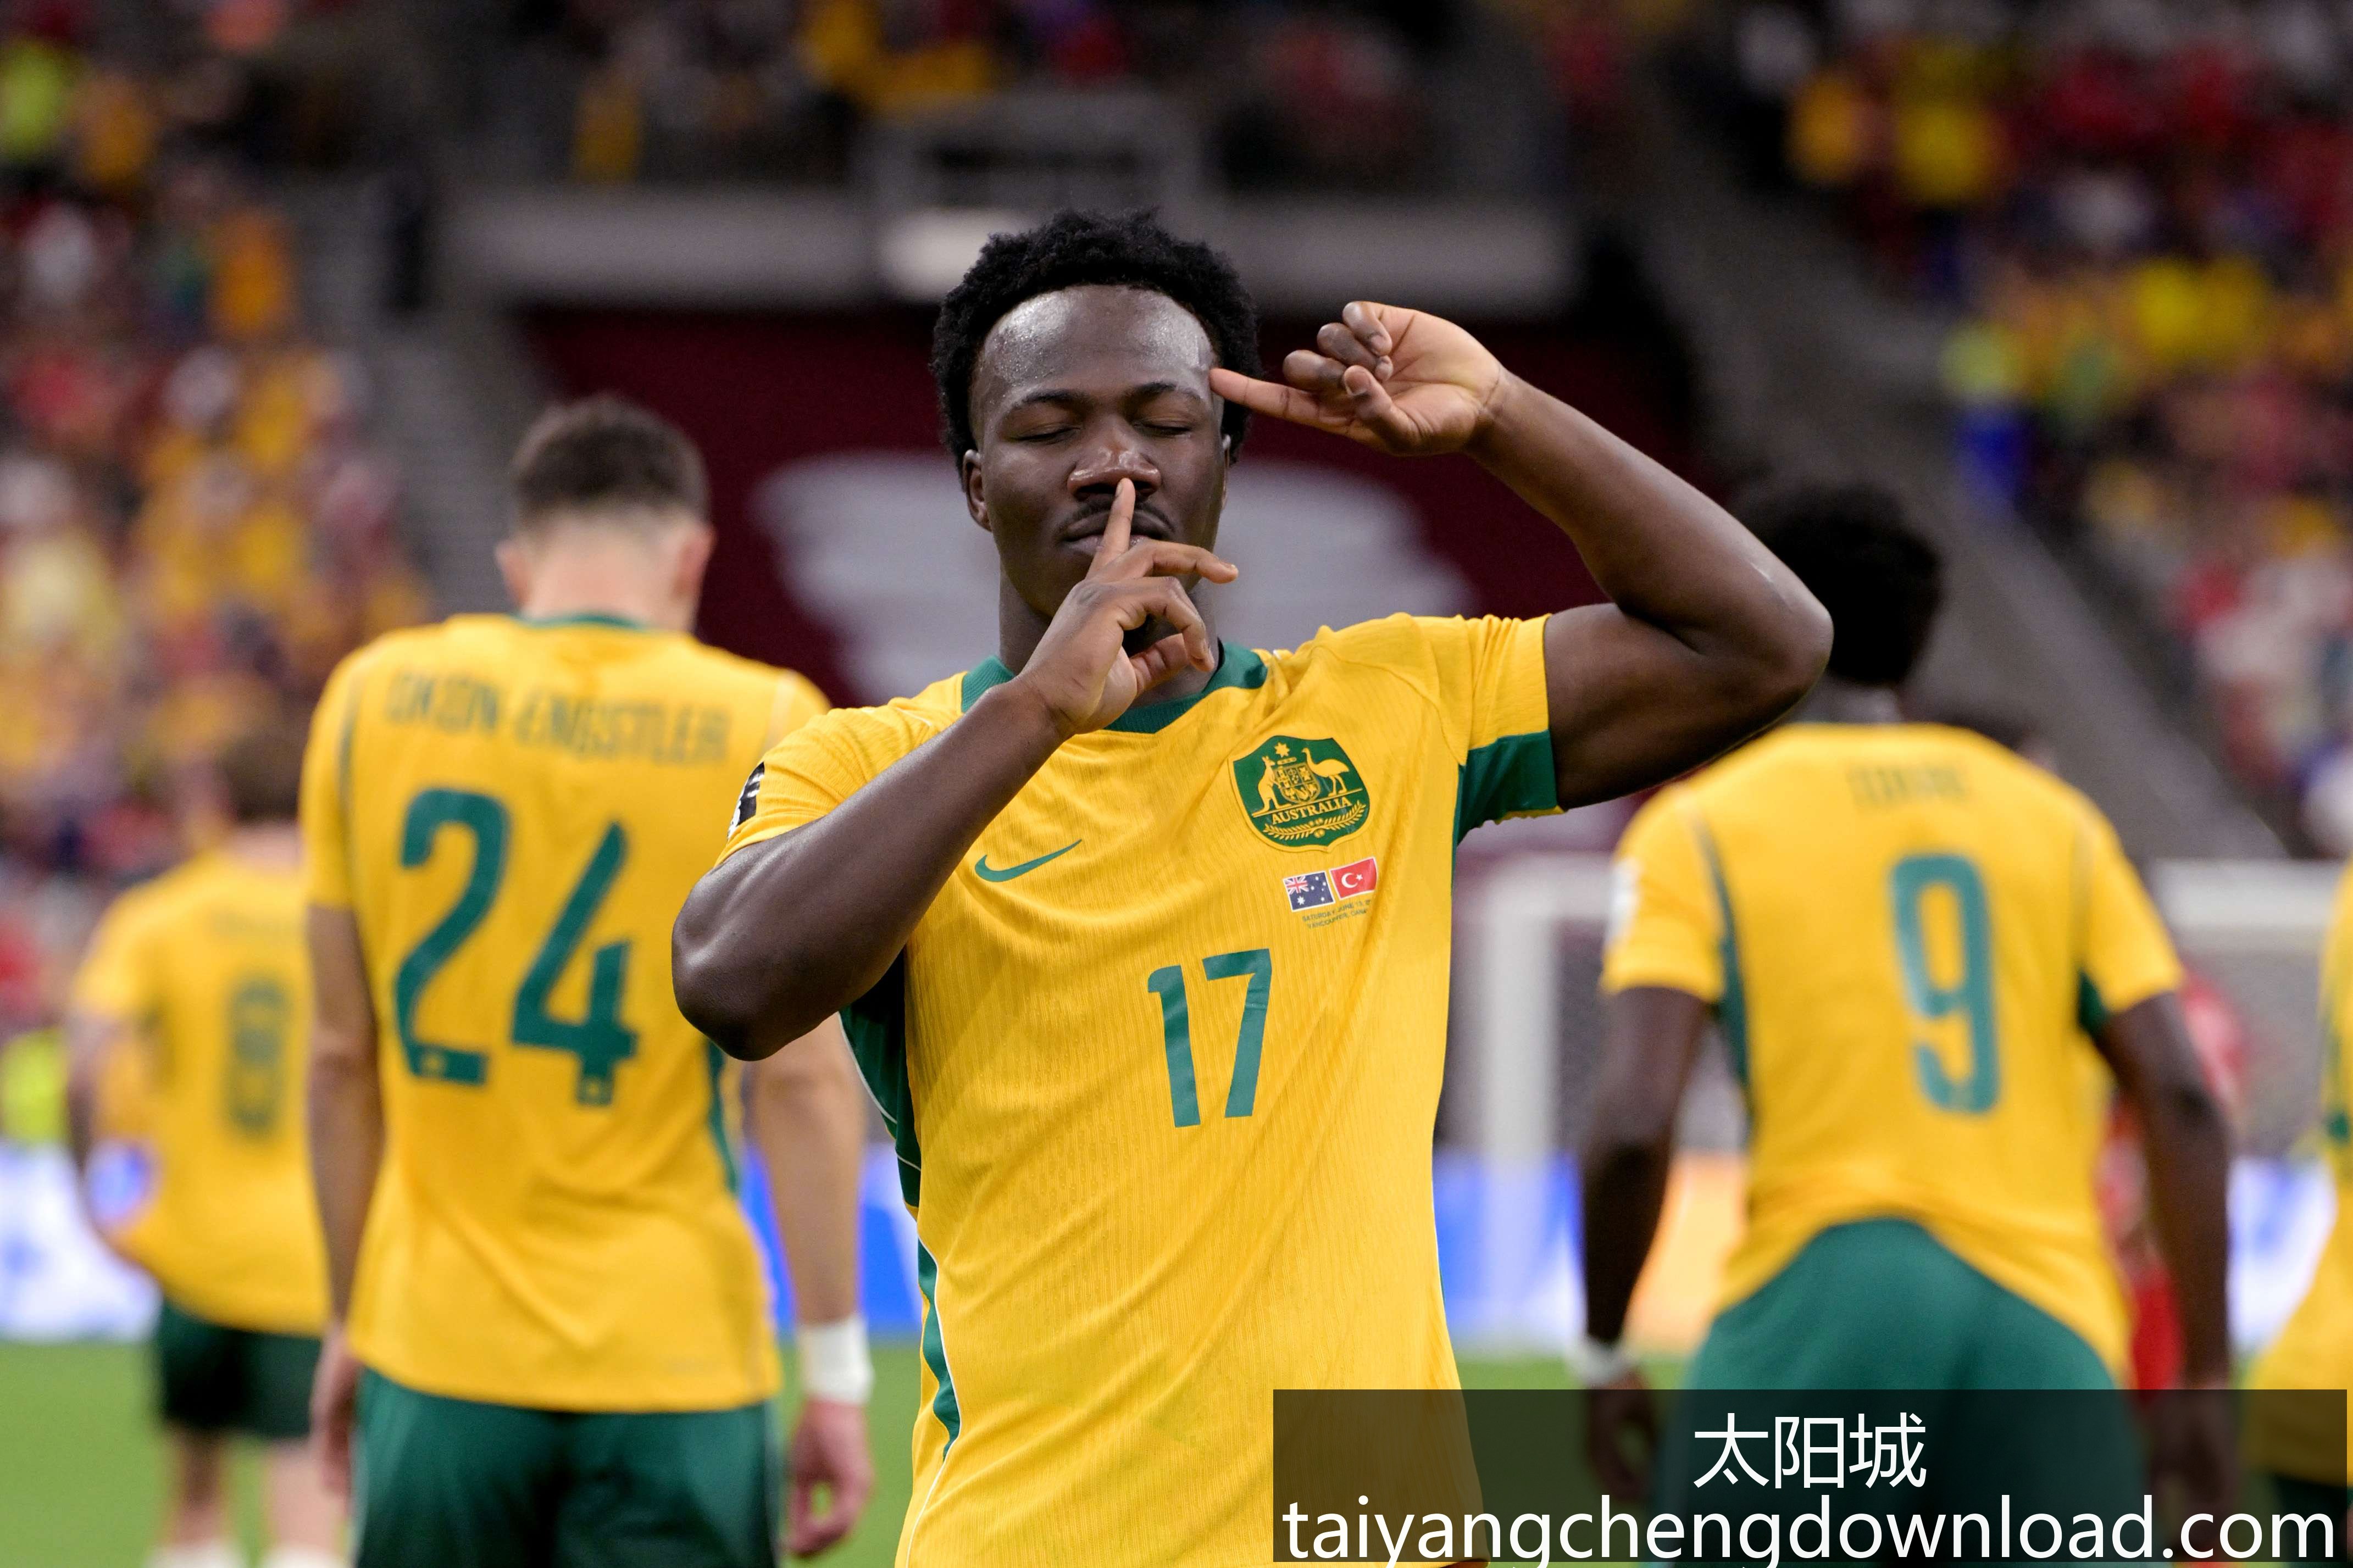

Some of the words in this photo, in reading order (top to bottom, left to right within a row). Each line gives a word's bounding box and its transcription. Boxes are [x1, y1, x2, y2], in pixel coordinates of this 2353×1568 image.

[1272, 797, 1353, 825] AUSTRALIA
[395, 788, 639, 1107] 24
[1147, 948, 1272, 1127] 17
[1888, 853, 2002, 1114] 9
